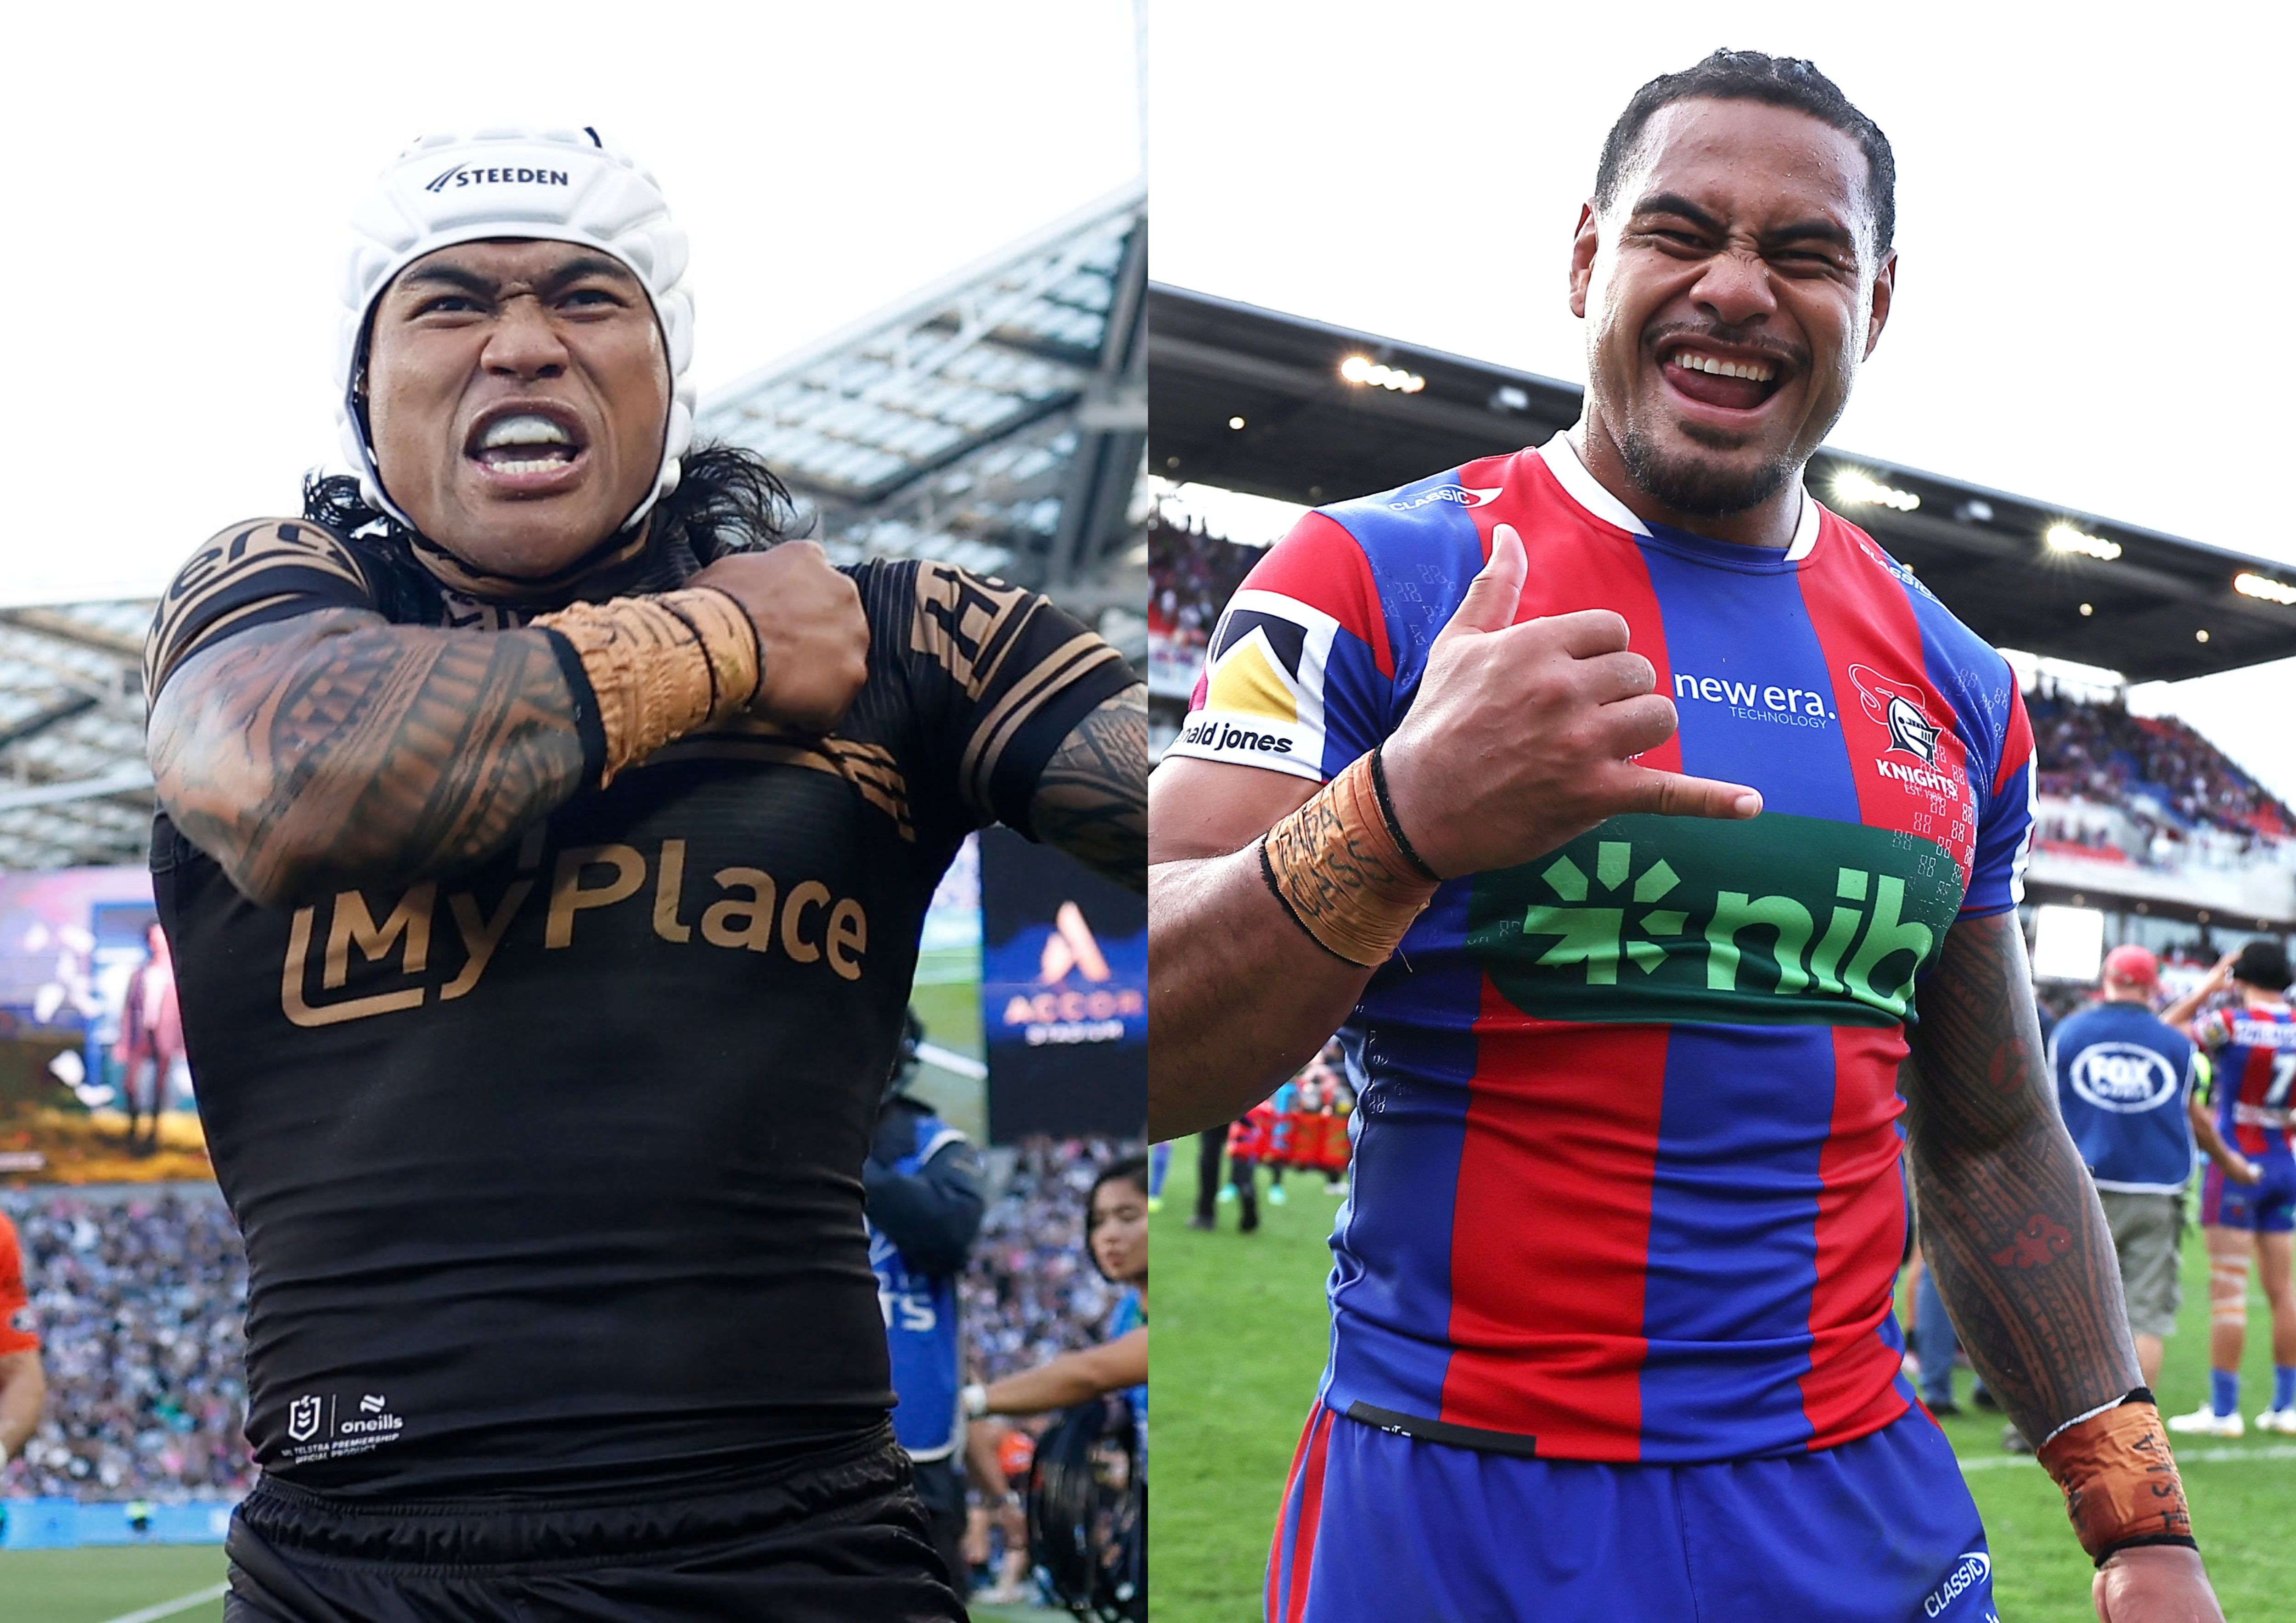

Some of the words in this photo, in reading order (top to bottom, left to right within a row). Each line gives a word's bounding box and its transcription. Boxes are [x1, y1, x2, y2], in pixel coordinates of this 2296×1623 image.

[456, 168, 568, 187] STEEDEN
[1388, 489, 1470, 511] CLASSIC
[1674, 673, 1757, 707] new
[1763, 685, 1836, 720] era.
[1176, 721, 1218, 745] nald
[1214, 723, 1294, 753] jones
[1728, 706, 1827, 729] TECHNOLOGY
[1874, 758, 1958, 797] KNIGHTS
[323, 839, 868, 1001] MyPlace
[1704, 867, 1934, 1016] nib
[2265, 1053, 2296, 1104] 7
[341, 1414, 403, 1433] oneills
[1924, 1559, 1984, 1618] CLASSIC
